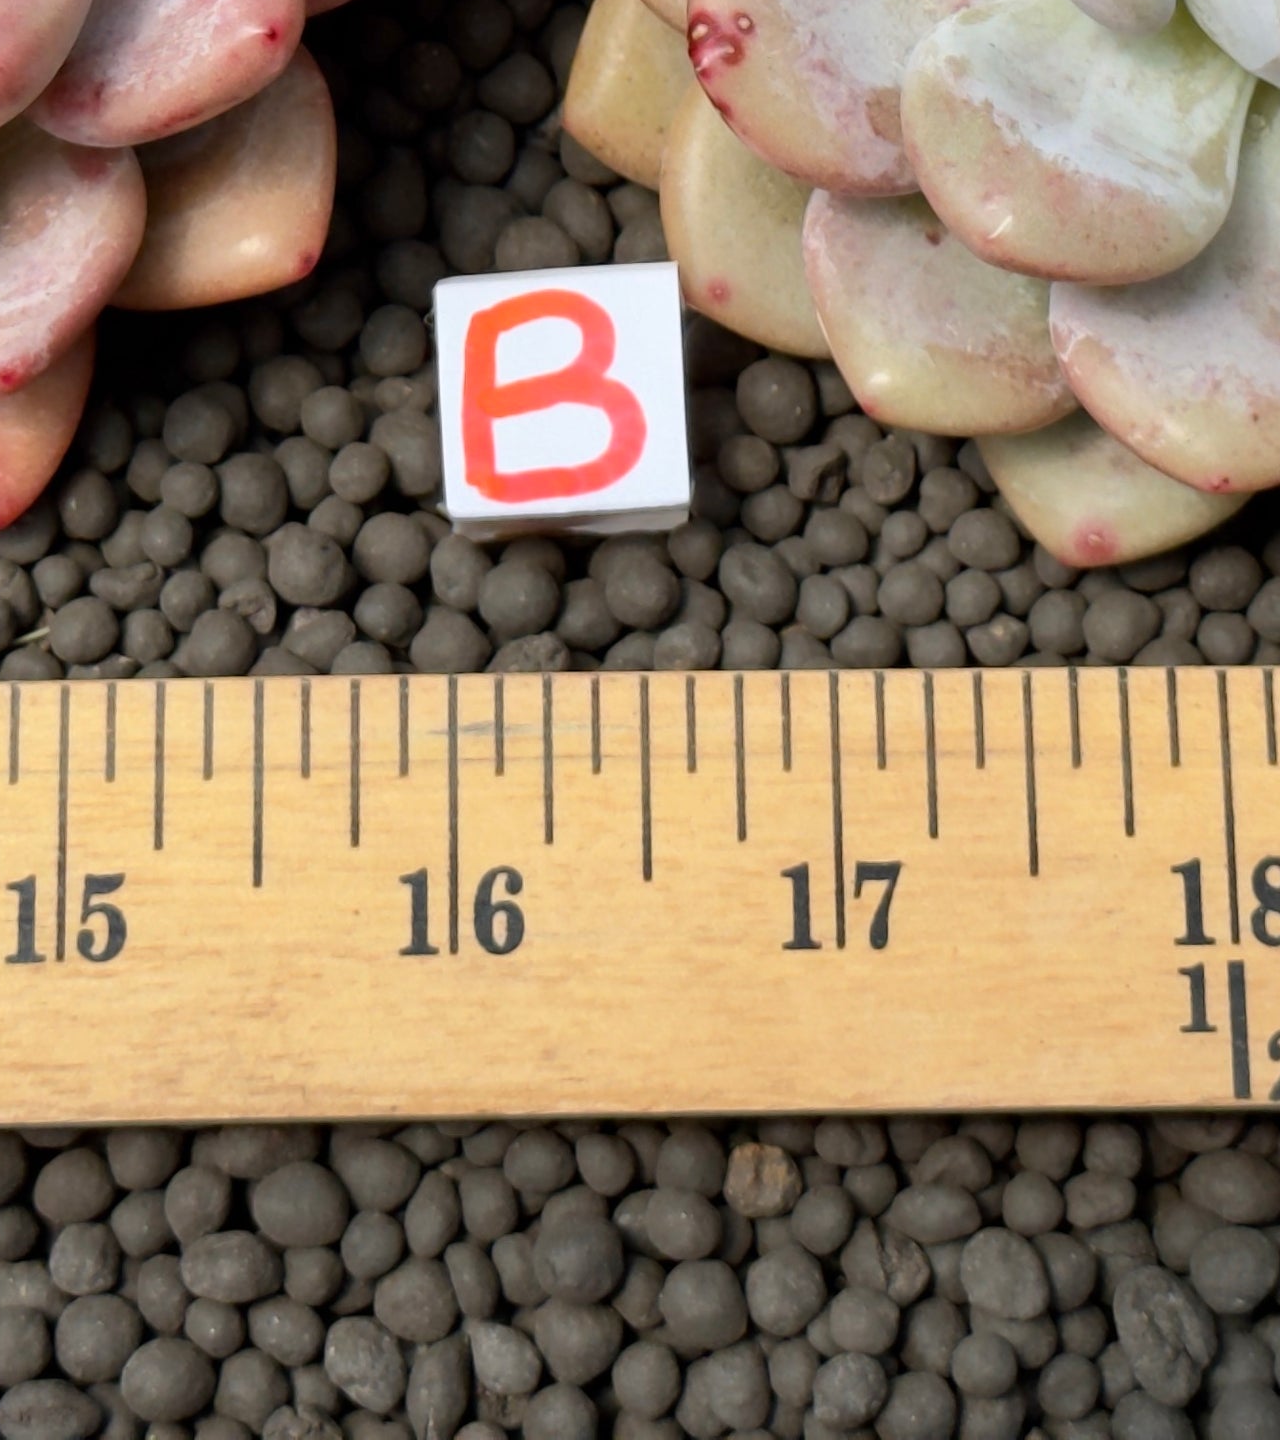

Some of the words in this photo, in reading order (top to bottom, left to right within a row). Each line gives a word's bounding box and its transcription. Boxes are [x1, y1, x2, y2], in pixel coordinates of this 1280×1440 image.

[461, 288, 647, 503] B
[3, 873, 128, 964] 15
[397, 865, 525, 956] 16
[780, 860, 903, 950] 17
